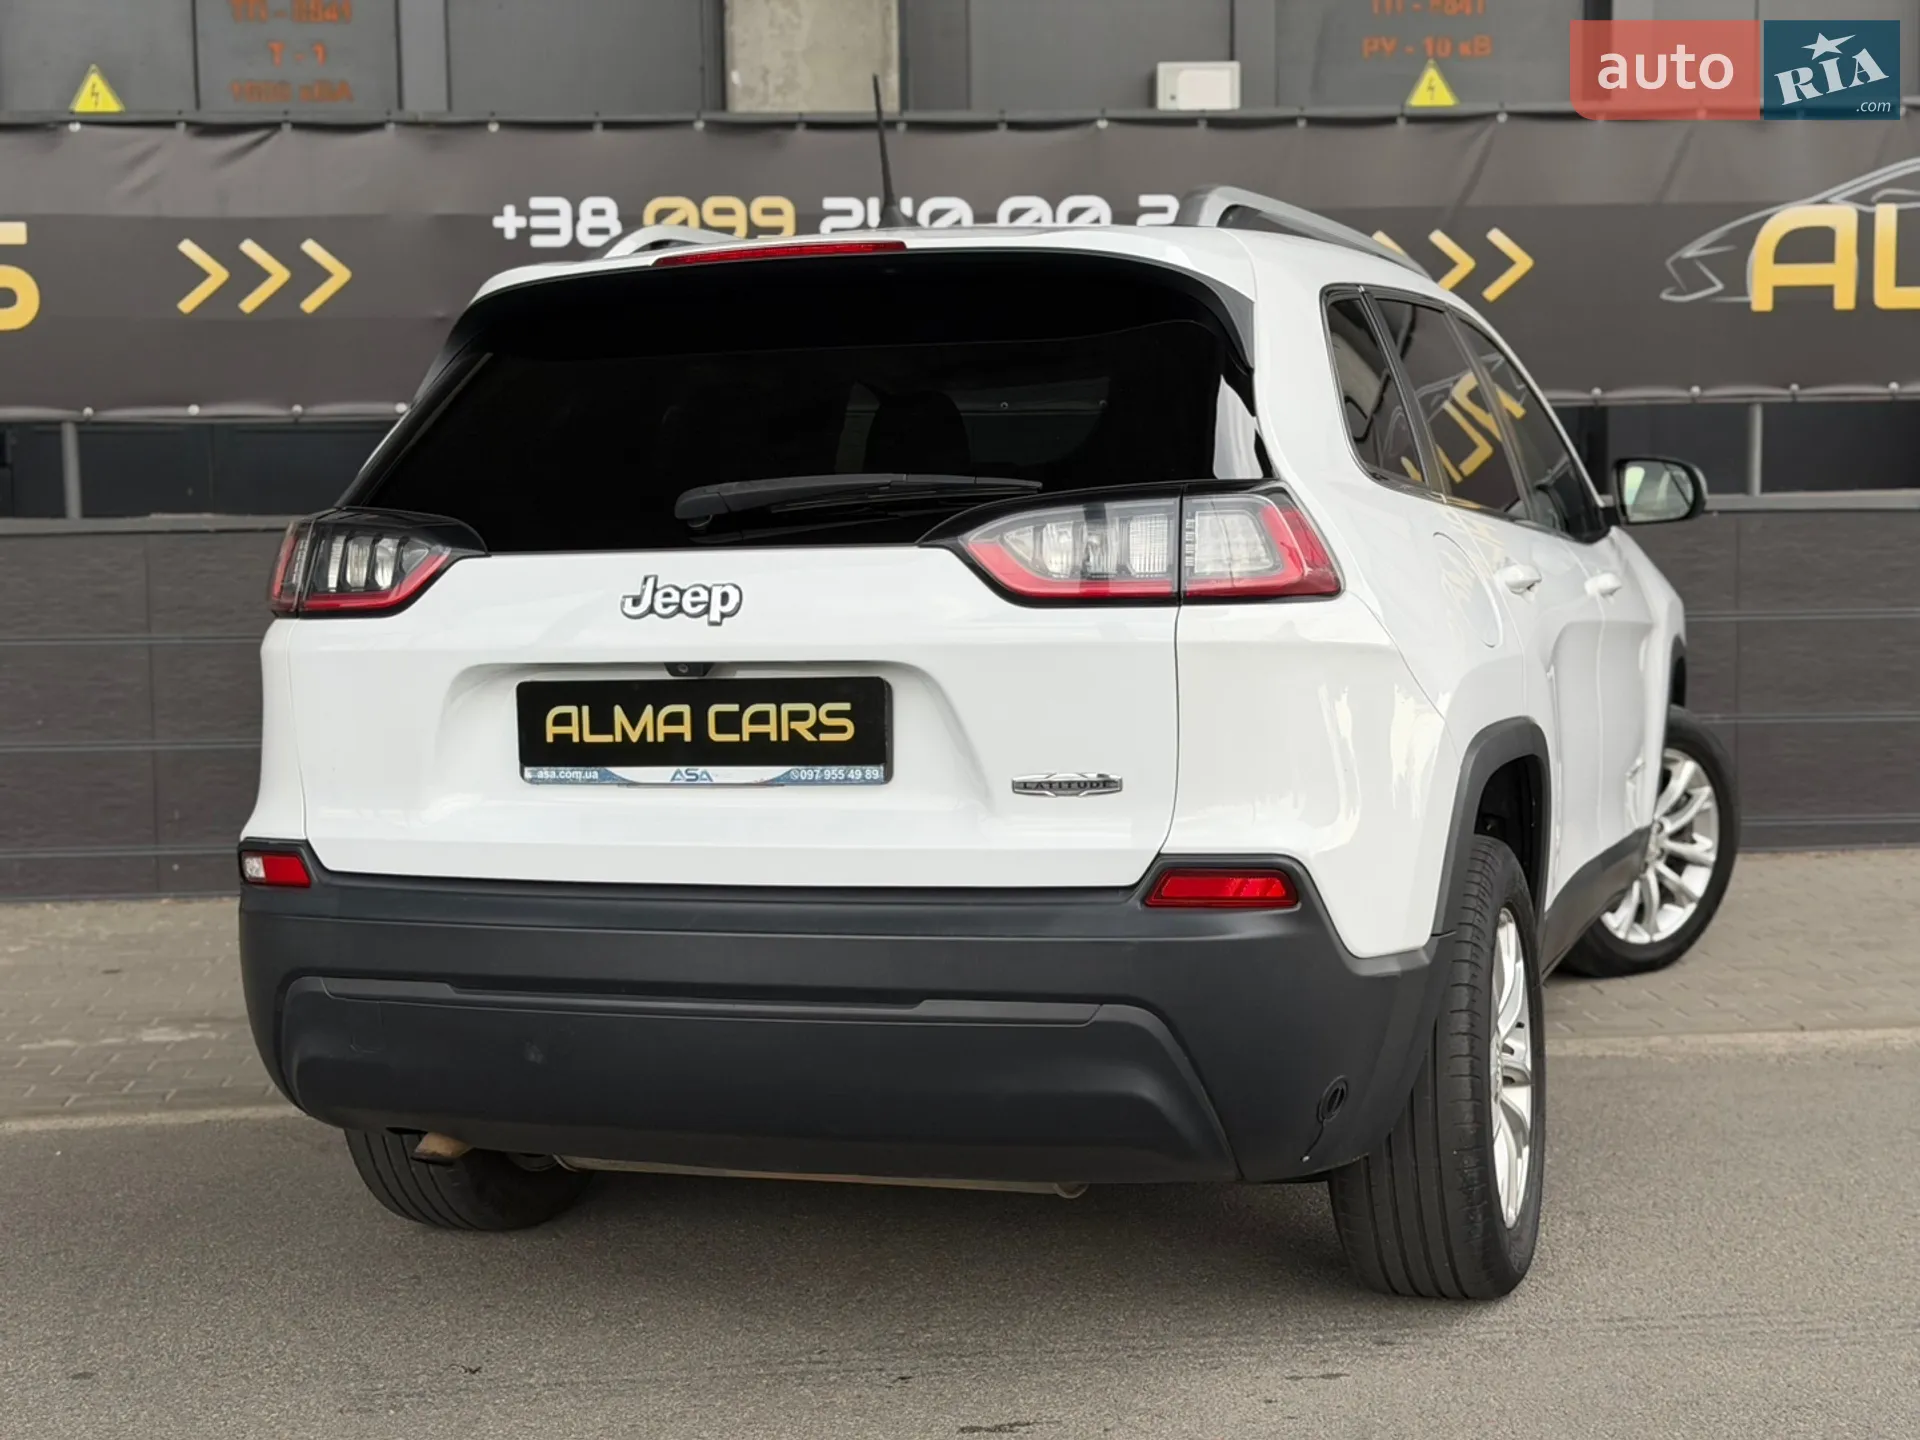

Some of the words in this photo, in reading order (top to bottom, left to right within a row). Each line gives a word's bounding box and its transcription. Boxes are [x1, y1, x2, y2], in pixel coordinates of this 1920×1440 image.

[492, 196, 621, 247] +38
[620, 574, 743, 626] Jeep
[545, 703, 691, 743] ALMA
[707, 702, 856, 742] CARS
[670, 768, 713, 783] ASA
